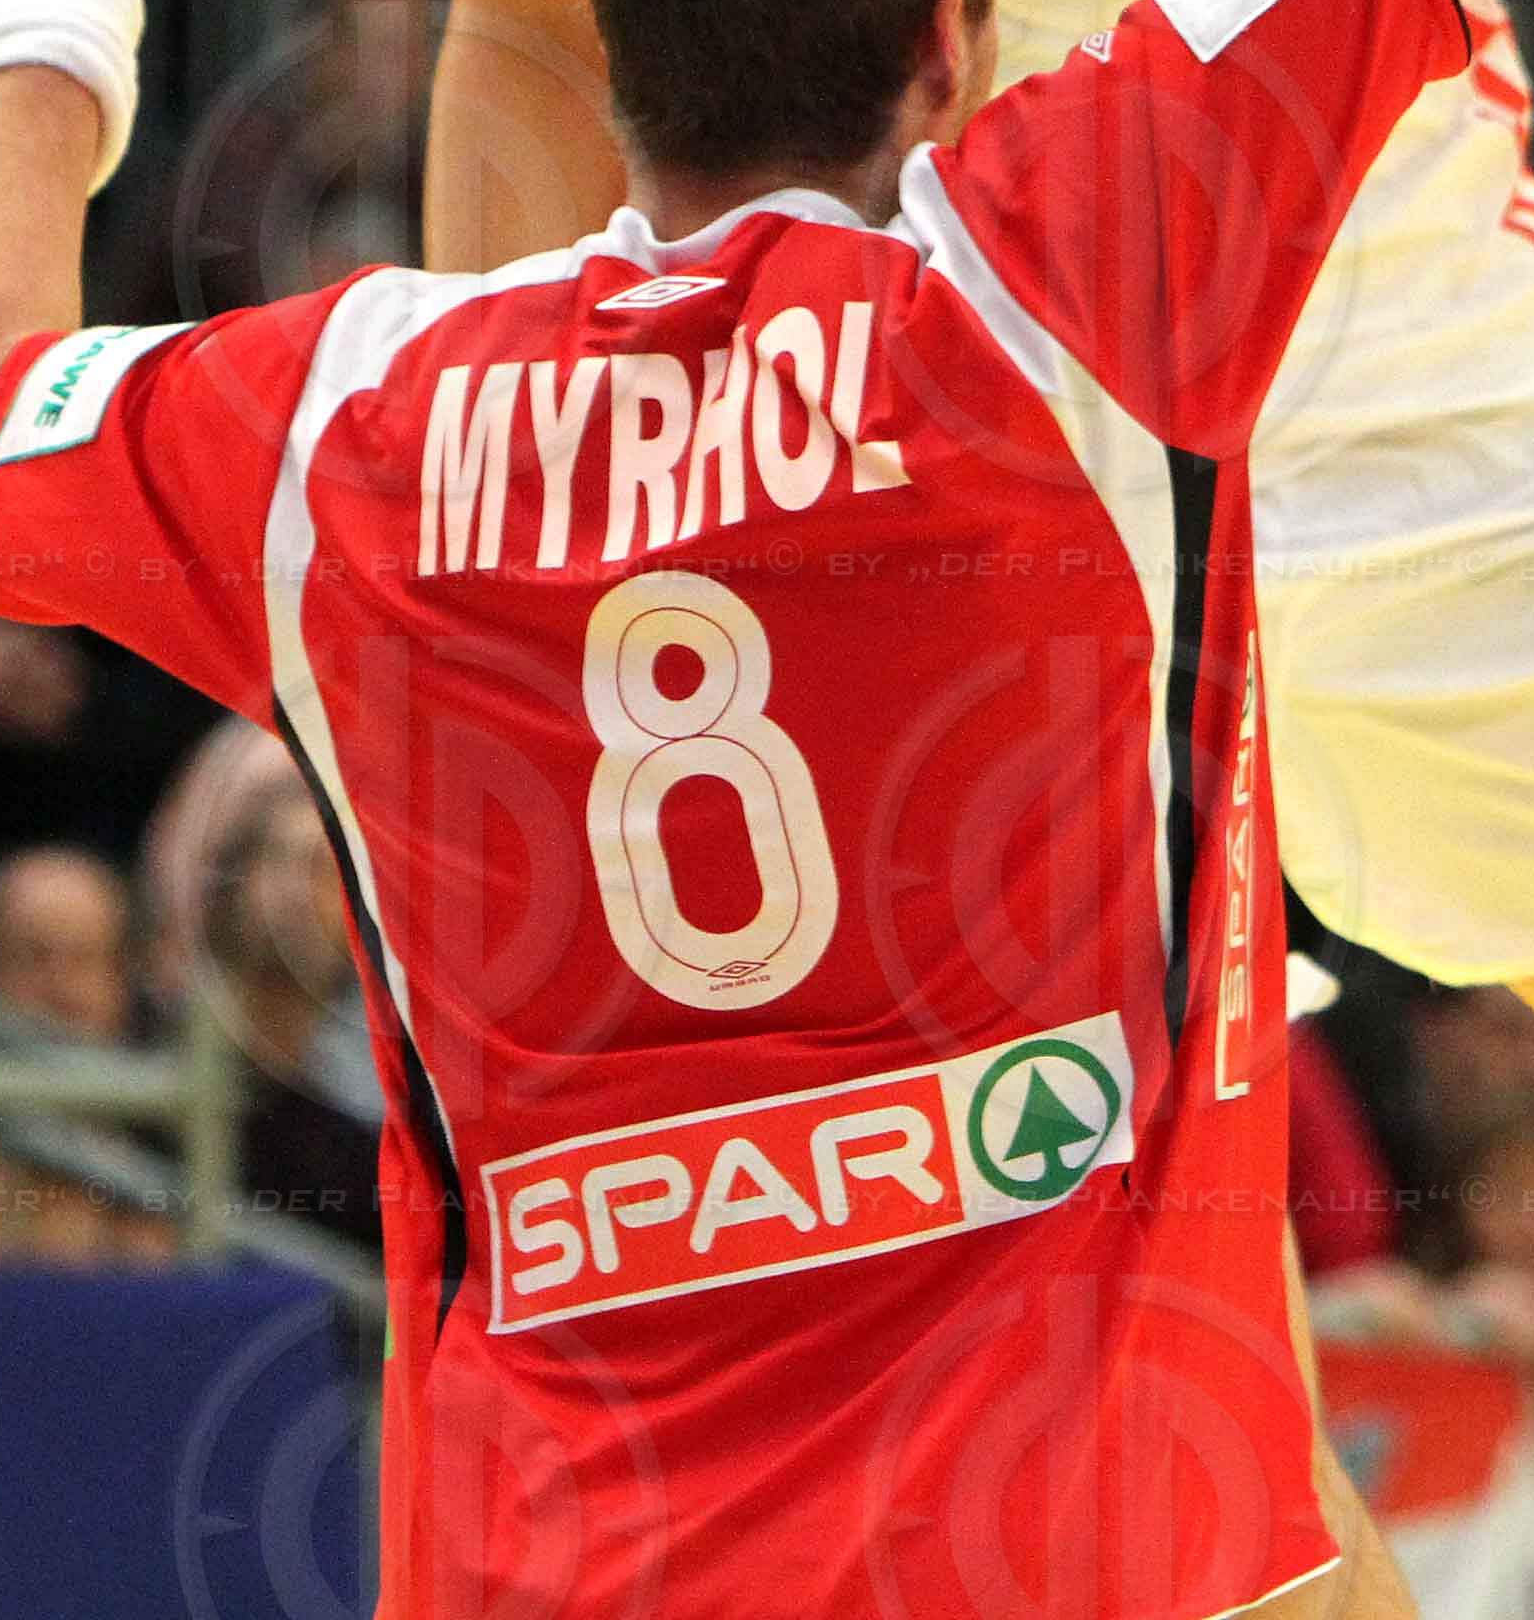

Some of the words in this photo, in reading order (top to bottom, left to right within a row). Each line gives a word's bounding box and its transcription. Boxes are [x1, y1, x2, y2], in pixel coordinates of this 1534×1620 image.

[417, 300, 913, 577] MYRHOL
[582, 569, 840, 1012] 8
[508, 1104, 945, 1297] SPAR
